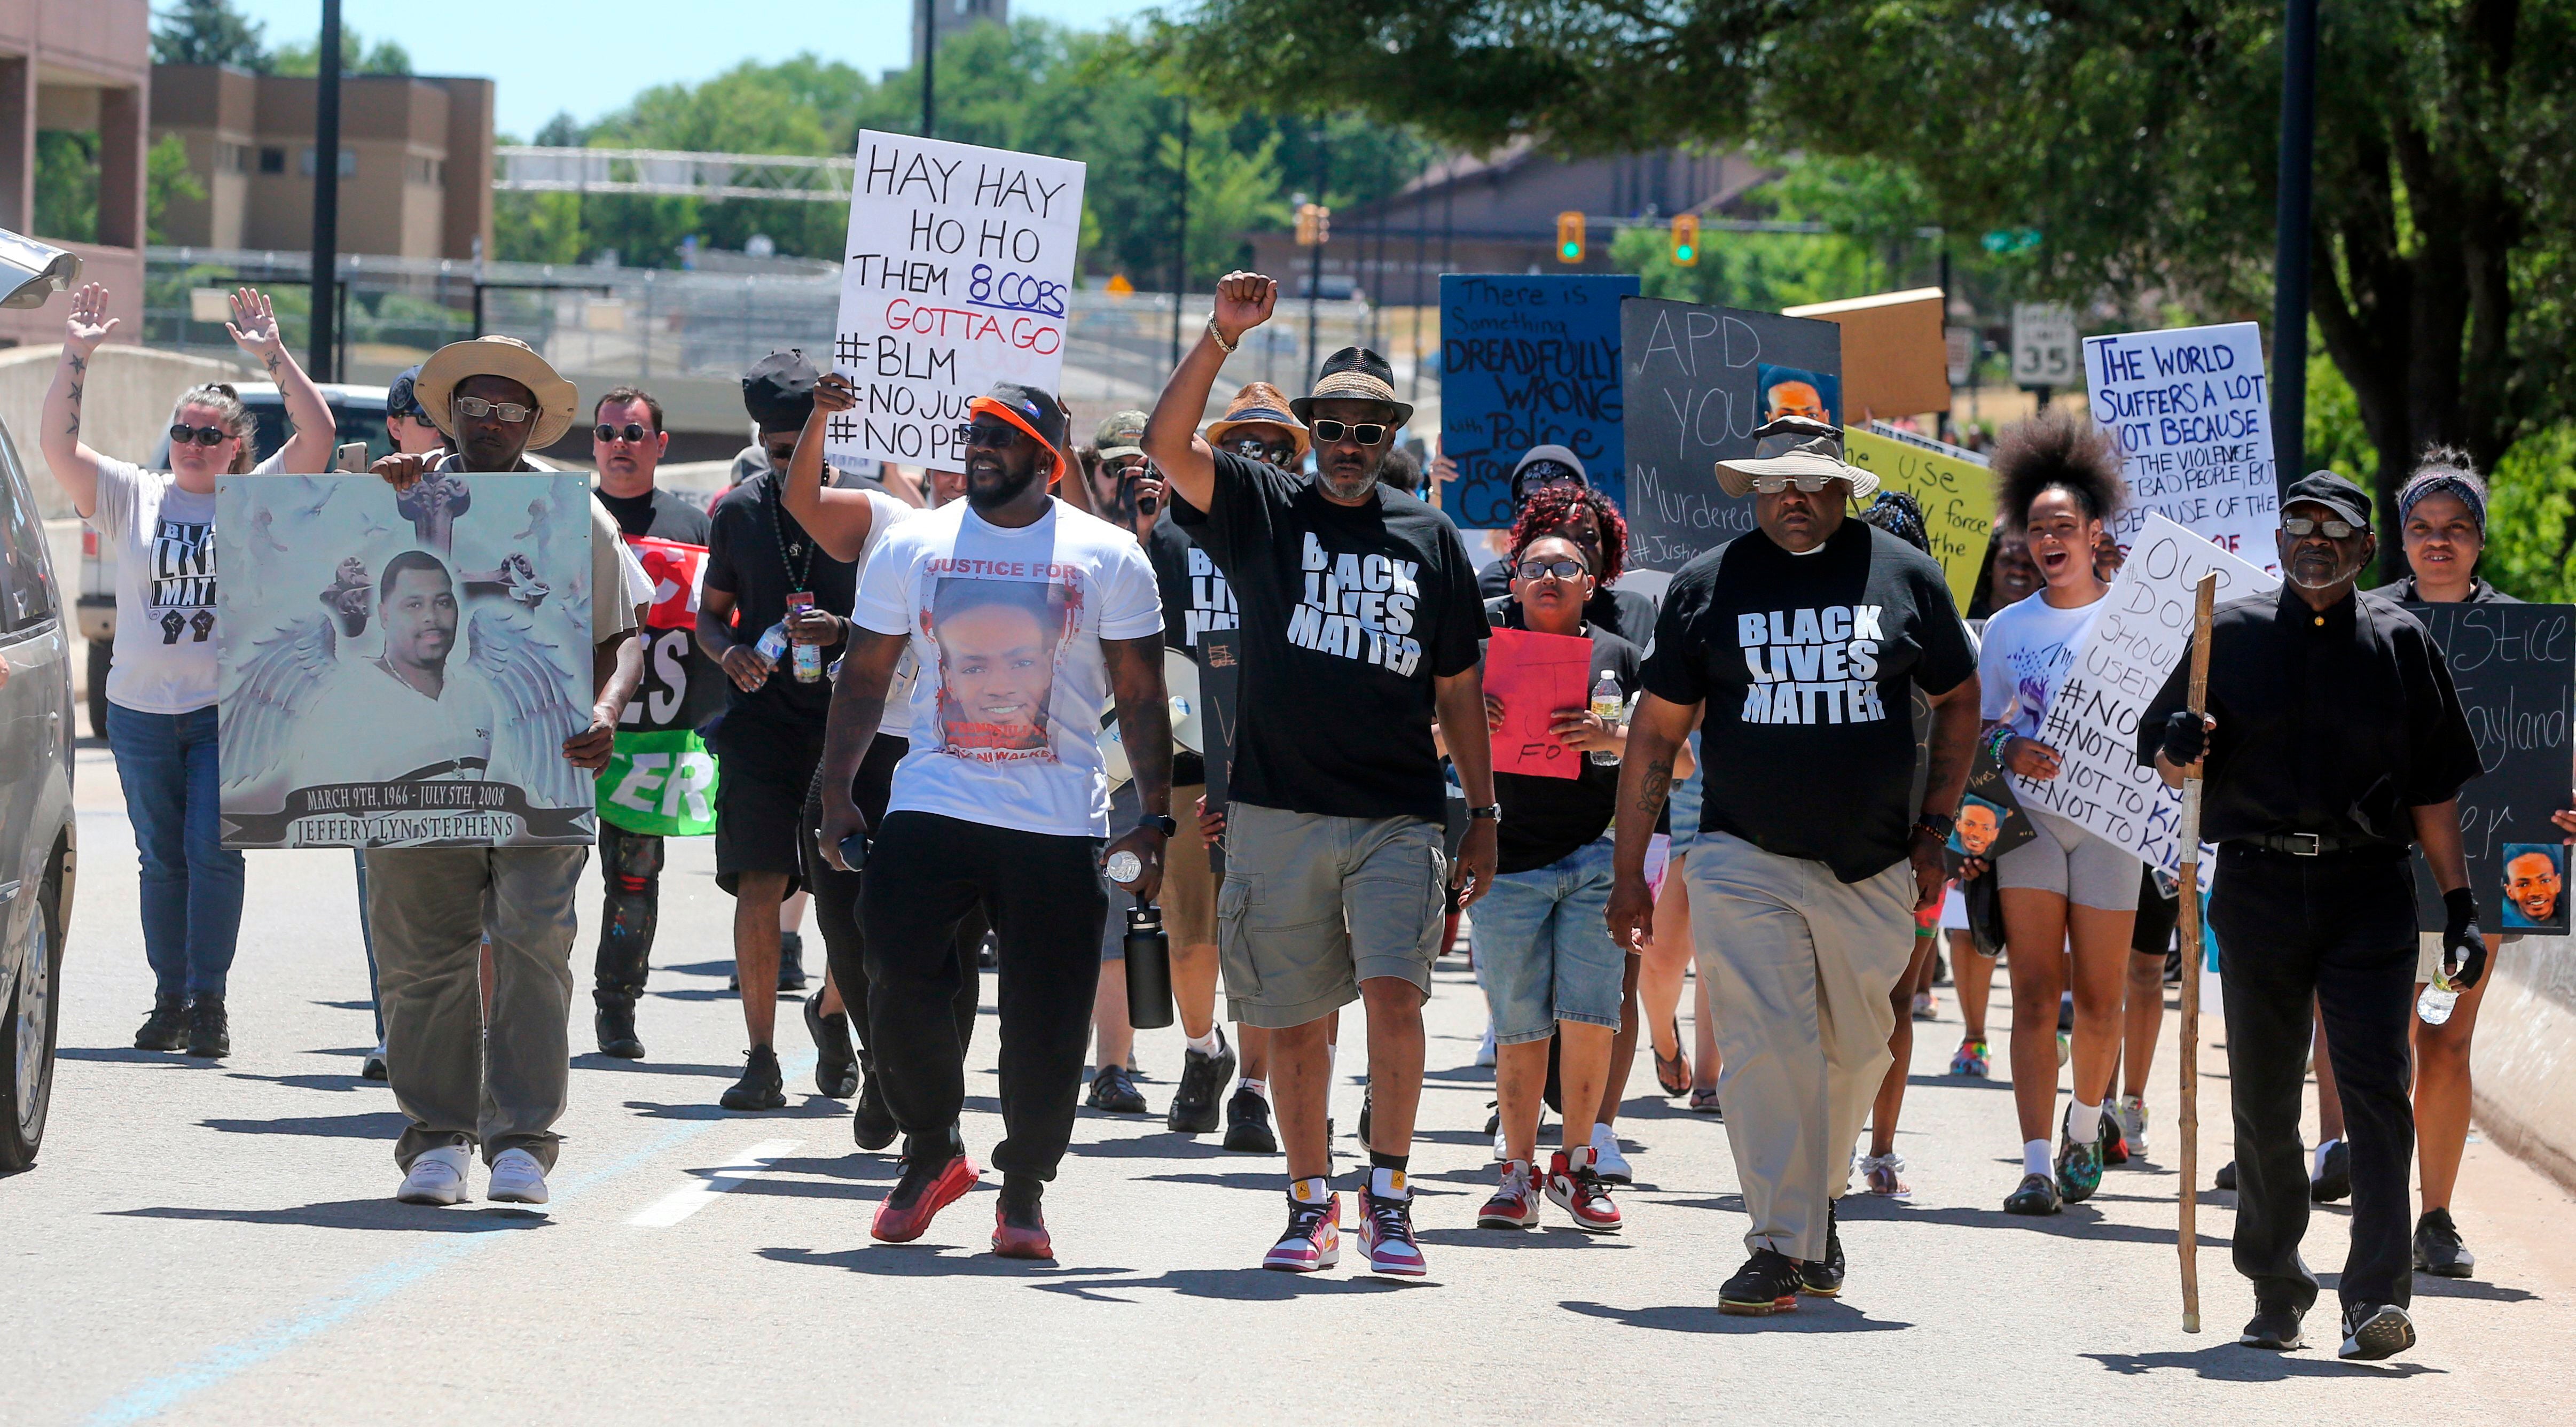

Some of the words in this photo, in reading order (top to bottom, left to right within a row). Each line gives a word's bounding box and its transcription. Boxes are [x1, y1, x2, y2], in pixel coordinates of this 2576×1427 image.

[866, 144, 962, 204] HAY
[975, 163, 1067, 219] HAY
[910, 209, 964, 254] HO
[979, 219, 1039, 263] HO
[852, 254, 948, 296] THEM
[969, 263, 992, 301] 8
[998, 271, 1067, 316] COPS
[1461, 278, 1548, 306] There
[1561, 281, 1588, 305] is
[886, 298, 1006, 343] GOTTA
[1012, 317, 1060, 355] GO
[1452, 306, 1570, 342] Something
[1639, 309, 1760, 377] APD
[835, 332, 956, 385] #BLM
[1445, 335, 1623, 382] DREADFULLY
[2020, 346, 2068, 376] 35
[2087, 338, 2146, 386] THE
[2151, 344, 2234, 378] WORLD
[1495, 373, 1624, 423] WRONG
[2095, 383, 2198, 425] SUFFERS
[2203, 381, 2217, 408] A
[2223, 375, 2265, 403] LOT
[1485, 409, 1604, 459] Police
[1663, 387, 1756, 460] YOU
[2160, 409, 2260, 446] BECAUSE
[2137, 453, 2173, 475] THE
[2176, 442, 2258, 469] VIOLENCE
[2139, 474, 2182, 497] BAD
[2250, 458, 2276, 486] BUT
[1635, 463, 1754, 532] Murdered
[1945, 498, 1989, 536] force
[2215, 496, 2240, 518] OF
[2245, 495, 2277, 515] THE
[159, 536, 216, 578] LIV
[1301, 531, 1420, 599] BACK
[1632, 533, 1706, 563] #Justic
[1928, 532, 1967, 557] the
[159, 577, 216, 605] MAT
[927, 559, 1024, 577] JUSTICE
[1032, 563, 1078, 580] FOR
[1304, 572, 1416, 635] LIVES
[1737, 605, 1884, 648] BLACK
[1287, 603, 1422, 678] MATTER
[1744, 640, 1879, 683] LIVES
[2086, 645, 2160, 702] USED
[1741, 680, 1886, 724] MATTER
[2047, 706, 2125, 765] #NOT
[2455, 685, 2567, 773] ayland
[307, 790, 348, 811] MARCH
[353, 787, 381, 808] 9TH,
[384, 785, 409, 805] 1966
[420, 785, 447, 808] JULY
[449, 786, 475, 808] 5TH,
[479, 787, 506, 806] 2008
[2018, 774, 2101, 823] #NOT
[2105, 810, 2133, 843] TO
[2117, 782, 2144, 814] TO
[296, 818, 374, 846] JEFFERY
[378, 816, 414, 841] LYN
[419, 814, 513, 838] STEPHENS
